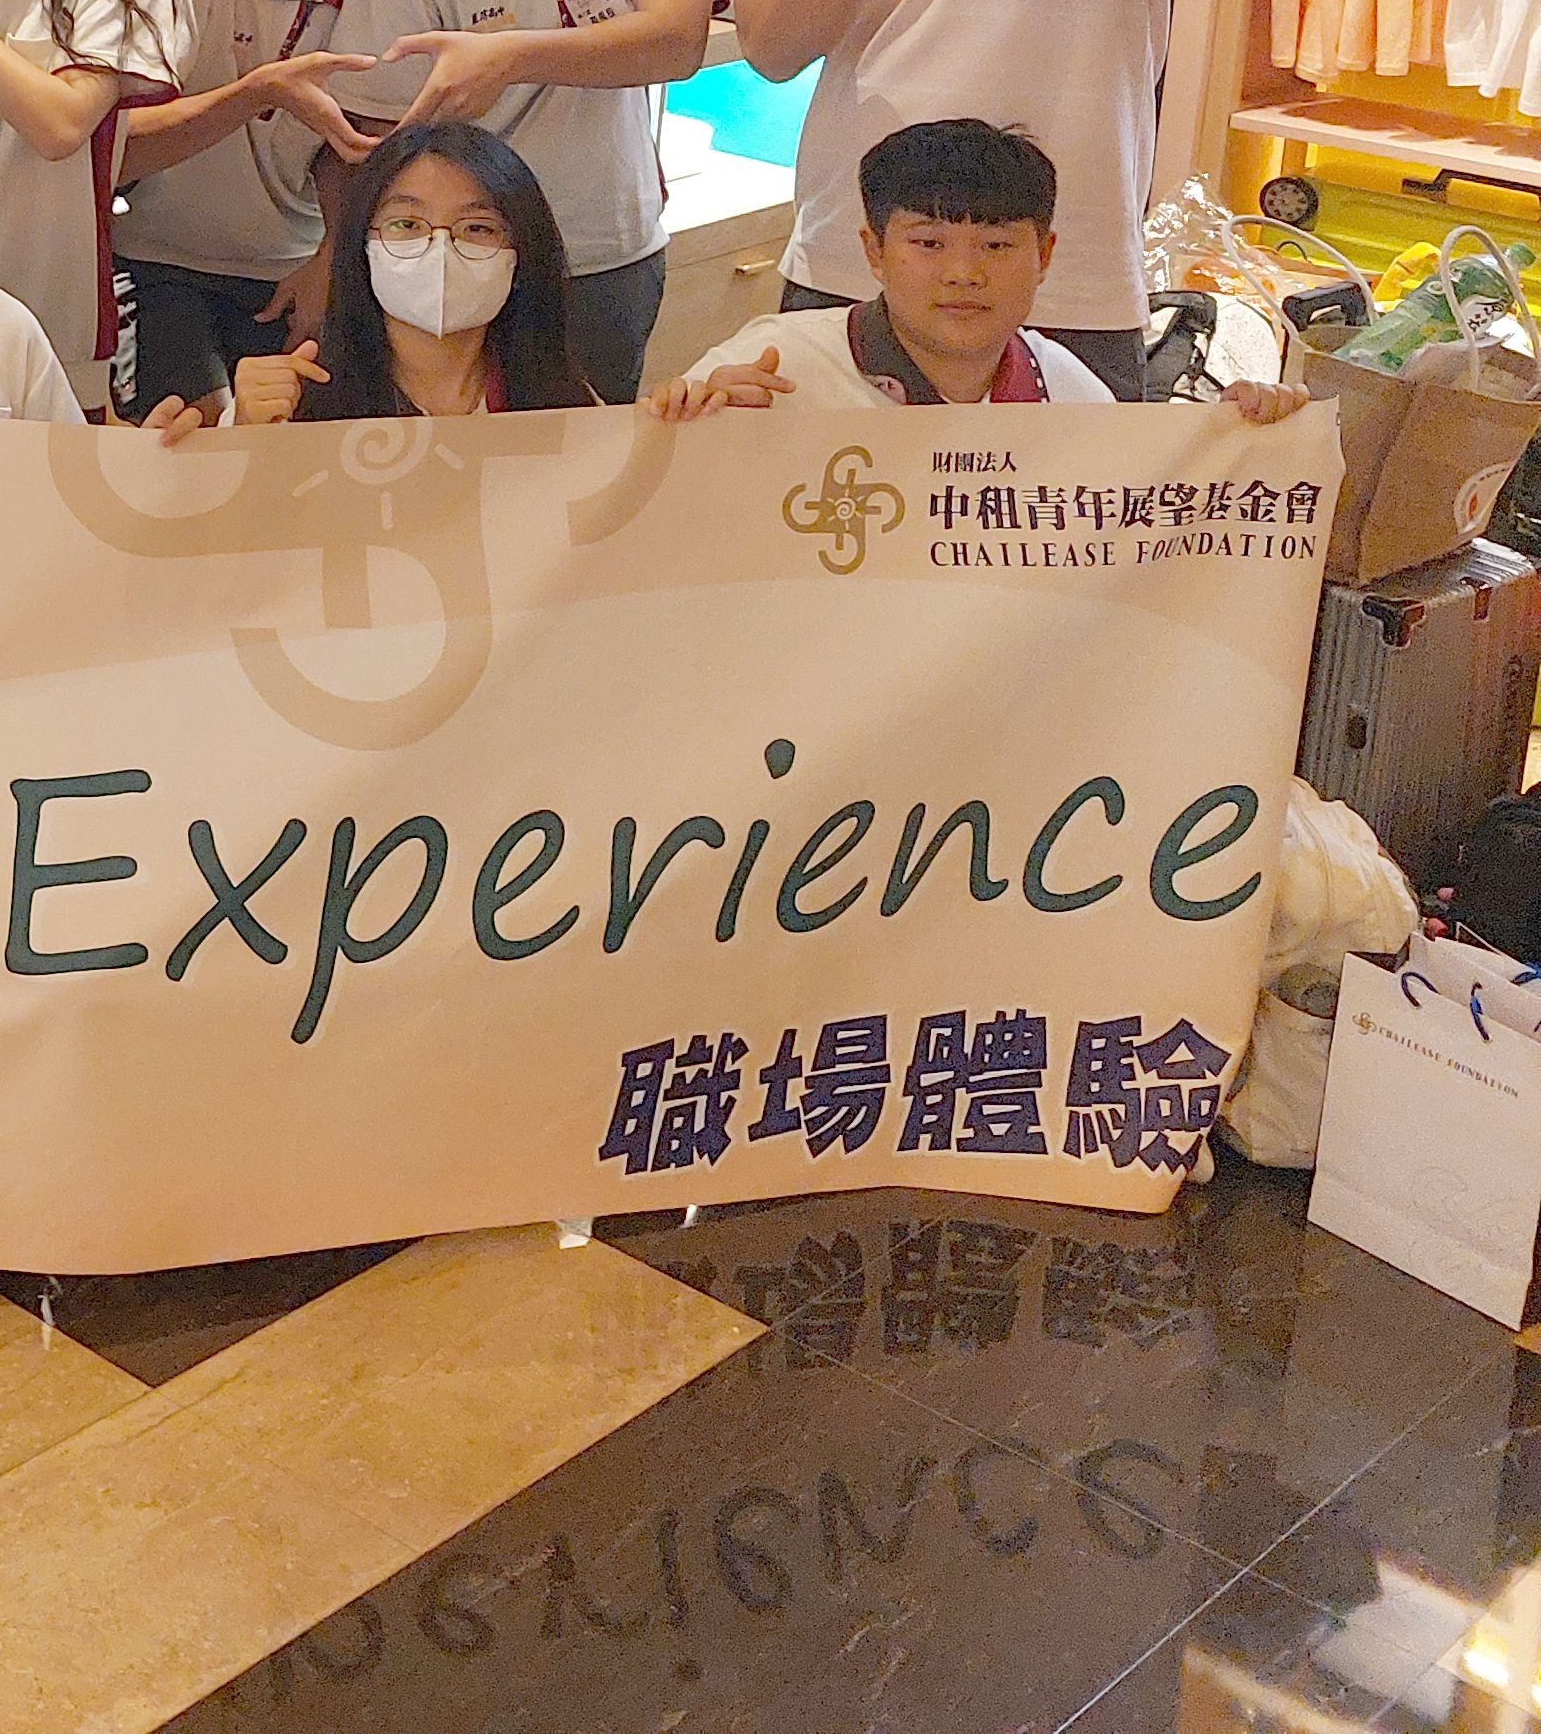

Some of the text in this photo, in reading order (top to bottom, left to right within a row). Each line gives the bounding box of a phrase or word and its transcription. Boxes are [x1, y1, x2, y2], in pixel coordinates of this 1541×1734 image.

[931, 451, 1019, 474] 財團法人
[929, 478, 1324, 532] 中租青年展望基金會
[930, 531, 1317, 567] CHAILEASE FOUNDATION
[2, 738, 1262, 1046] Experience
[597, 1008, 1235, 1177] 職場體驗
[1378, 1026, 1519, 1099] CHAILEASE FOUNDATION
